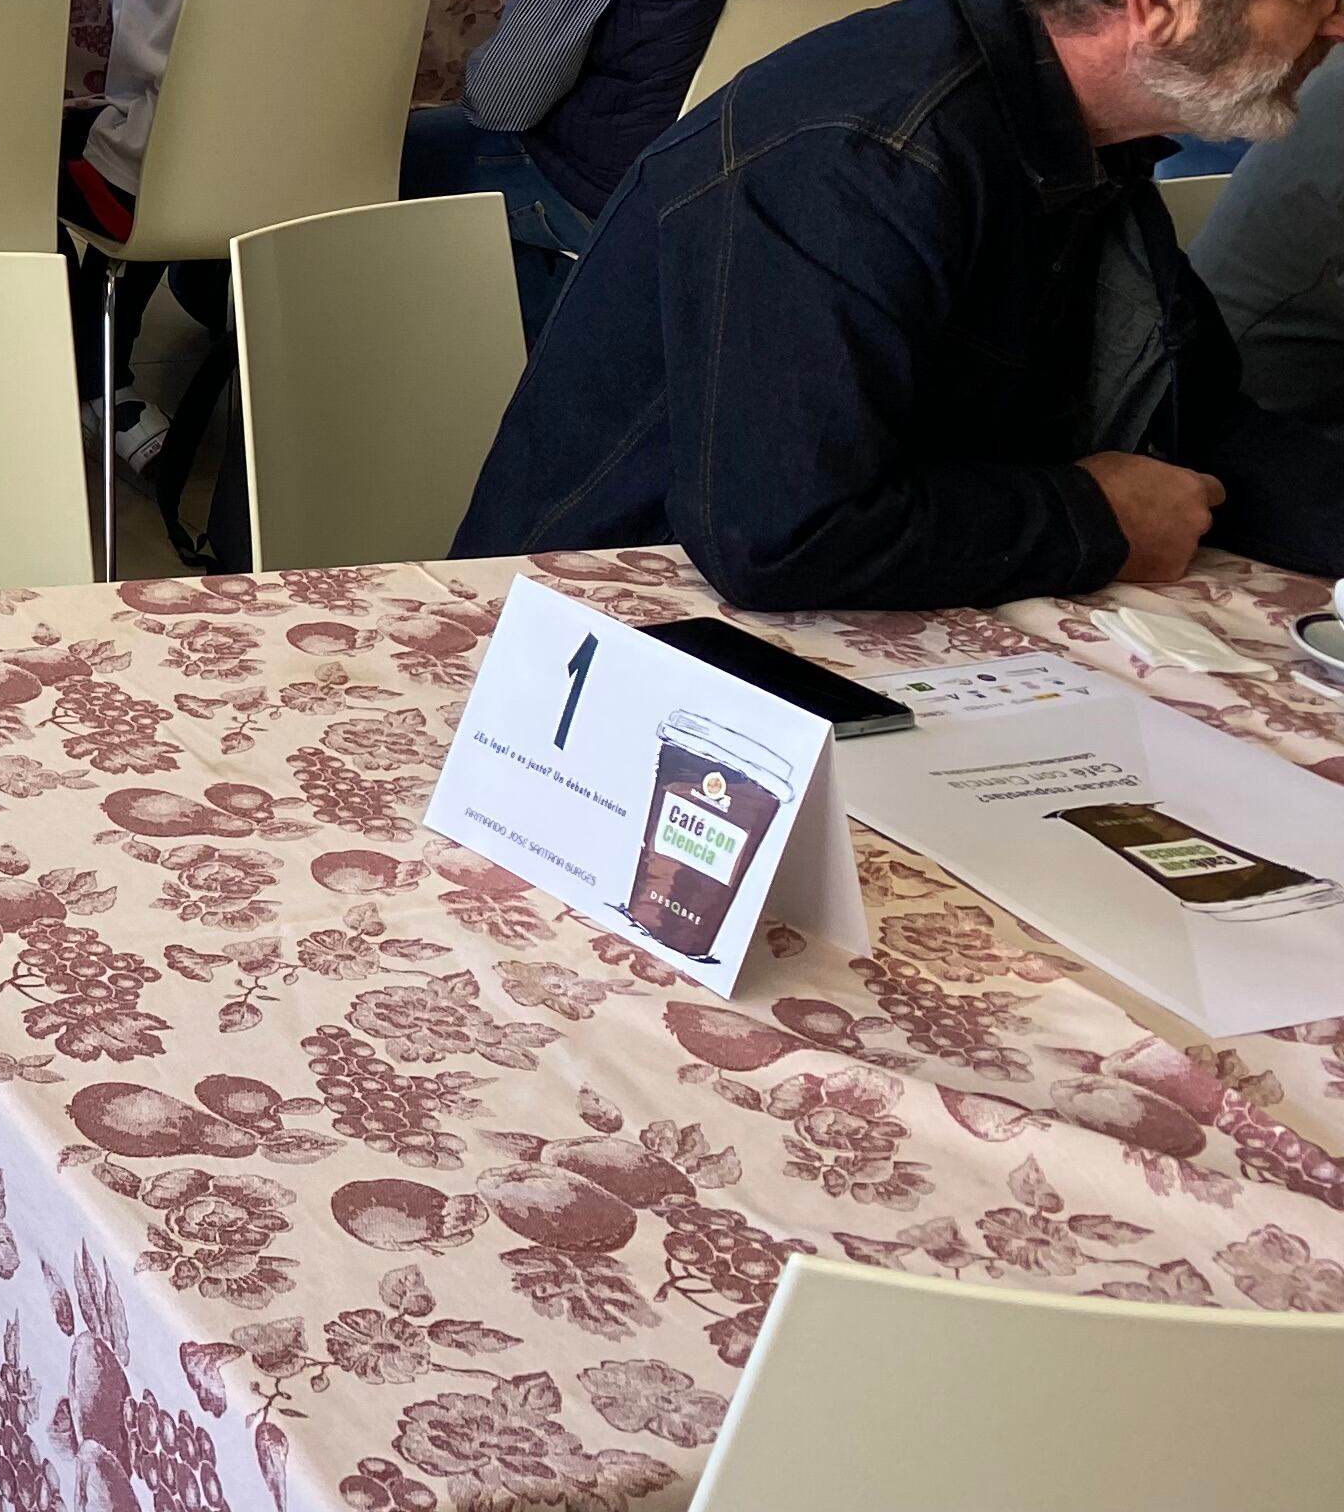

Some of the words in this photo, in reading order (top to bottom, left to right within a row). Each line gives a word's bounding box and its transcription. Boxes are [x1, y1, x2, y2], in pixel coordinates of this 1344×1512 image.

[554, 631, 599, 751] 1
[490, 737, 511, 755] legal
[525, 758, 553, 776] justo?
[553, 770, 565, 784] Un
[566, 777, 591, 798] debate
[593, 790, 627, 817] histórico
[947, 774, 1030, 792] Ciencia
[1027, 769, 1068, 784] con
[1070, 761, 1123, 779] Café
[974, 785, 1075, 804] respuestas?
[464, 807, 507, 836] ARMANDO
[669, 804, 705, 837] Café
[705, 827, 736, 853] con
[662, 824, 717, 866] Ciencia
